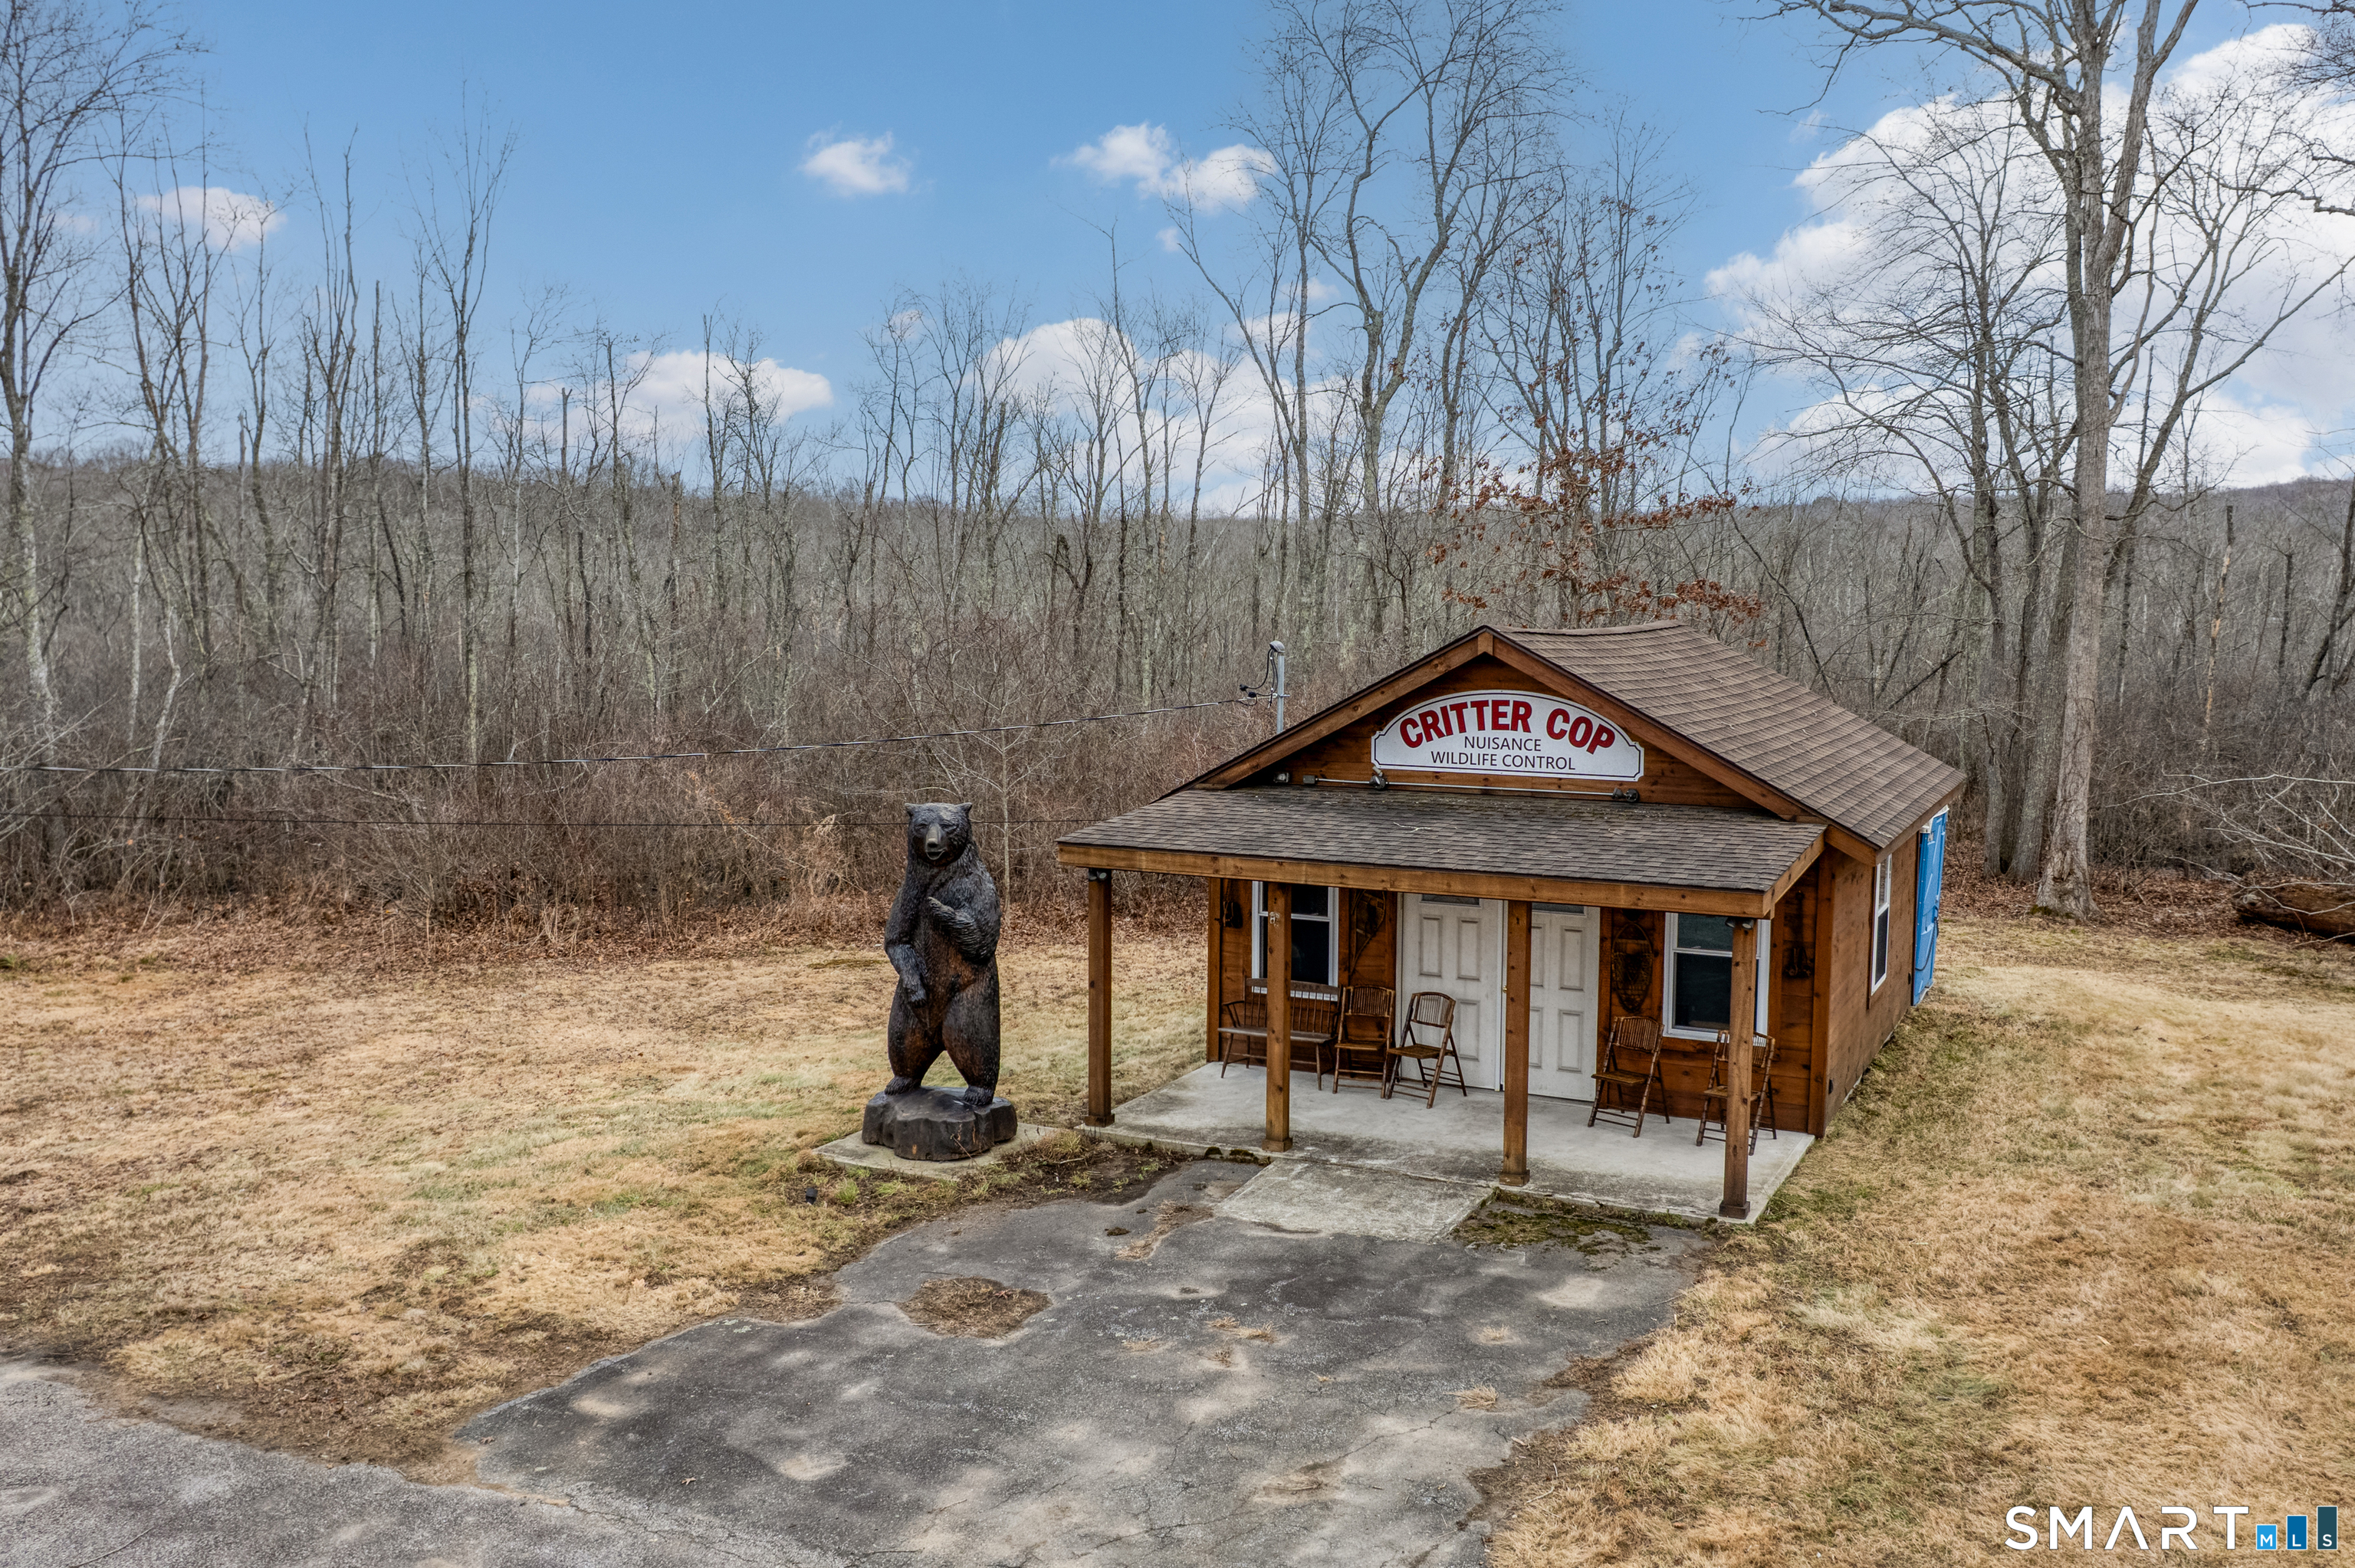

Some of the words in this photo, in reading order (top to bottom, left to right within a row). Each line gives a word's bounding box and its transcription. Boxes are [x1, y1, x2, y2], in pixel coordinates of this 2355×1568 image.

[1400, 700, 1532, 749] CRITTER
[1546, 708, 1615, 755] COP
[1464, 736, 1542, 752] NUISANCE
[1431, 751, 1497, 766] WILDLIFE
[1503, 754, 1576, 770] CONTROL
